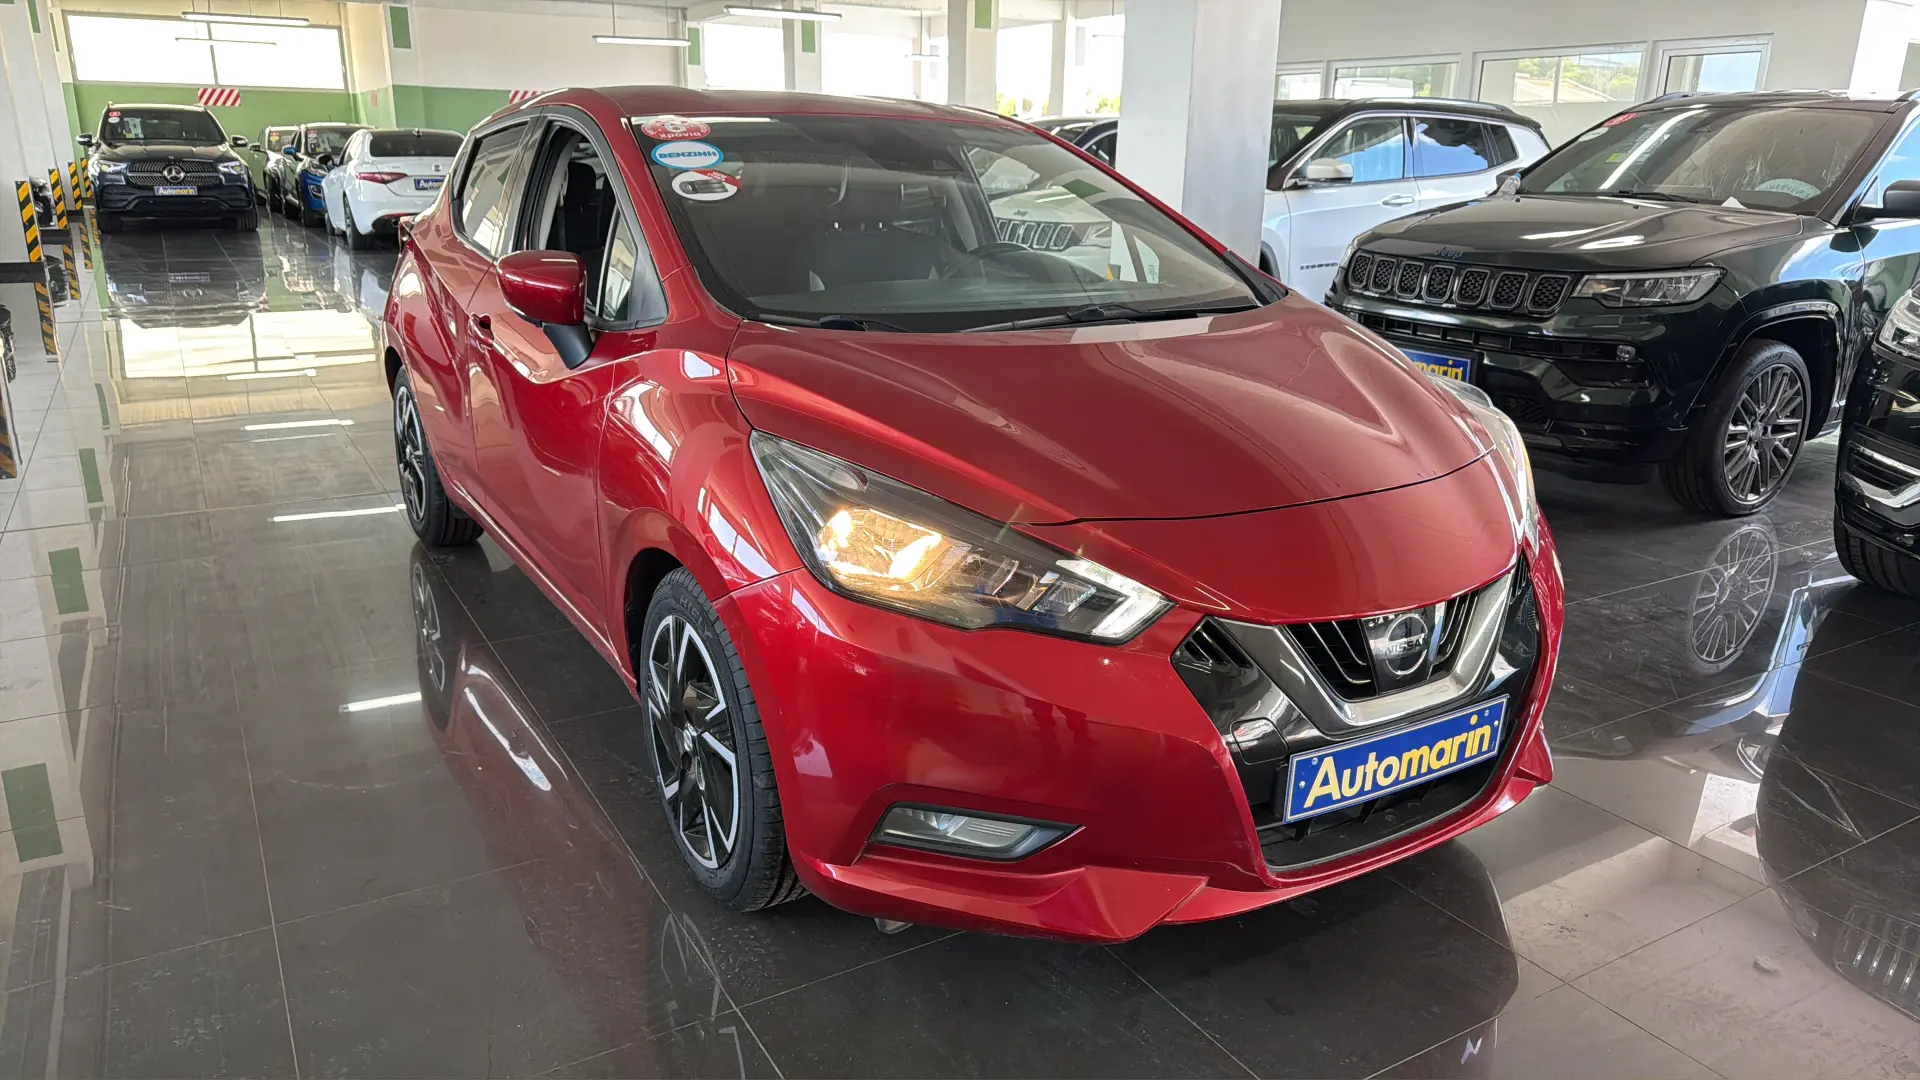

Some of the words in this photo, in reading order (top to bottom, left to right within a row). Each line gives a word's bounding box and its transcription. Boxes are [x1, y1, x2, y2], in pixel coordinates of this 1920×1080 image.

[158, 187, 195, 195] Automarin
[1434, 246, 1463, 260] Jeep
[680, 593, 713, 638] HIFLY
[1385, 635, 1429, 656] NISSAN
[1303, 714, 1492, 808] Automarin
